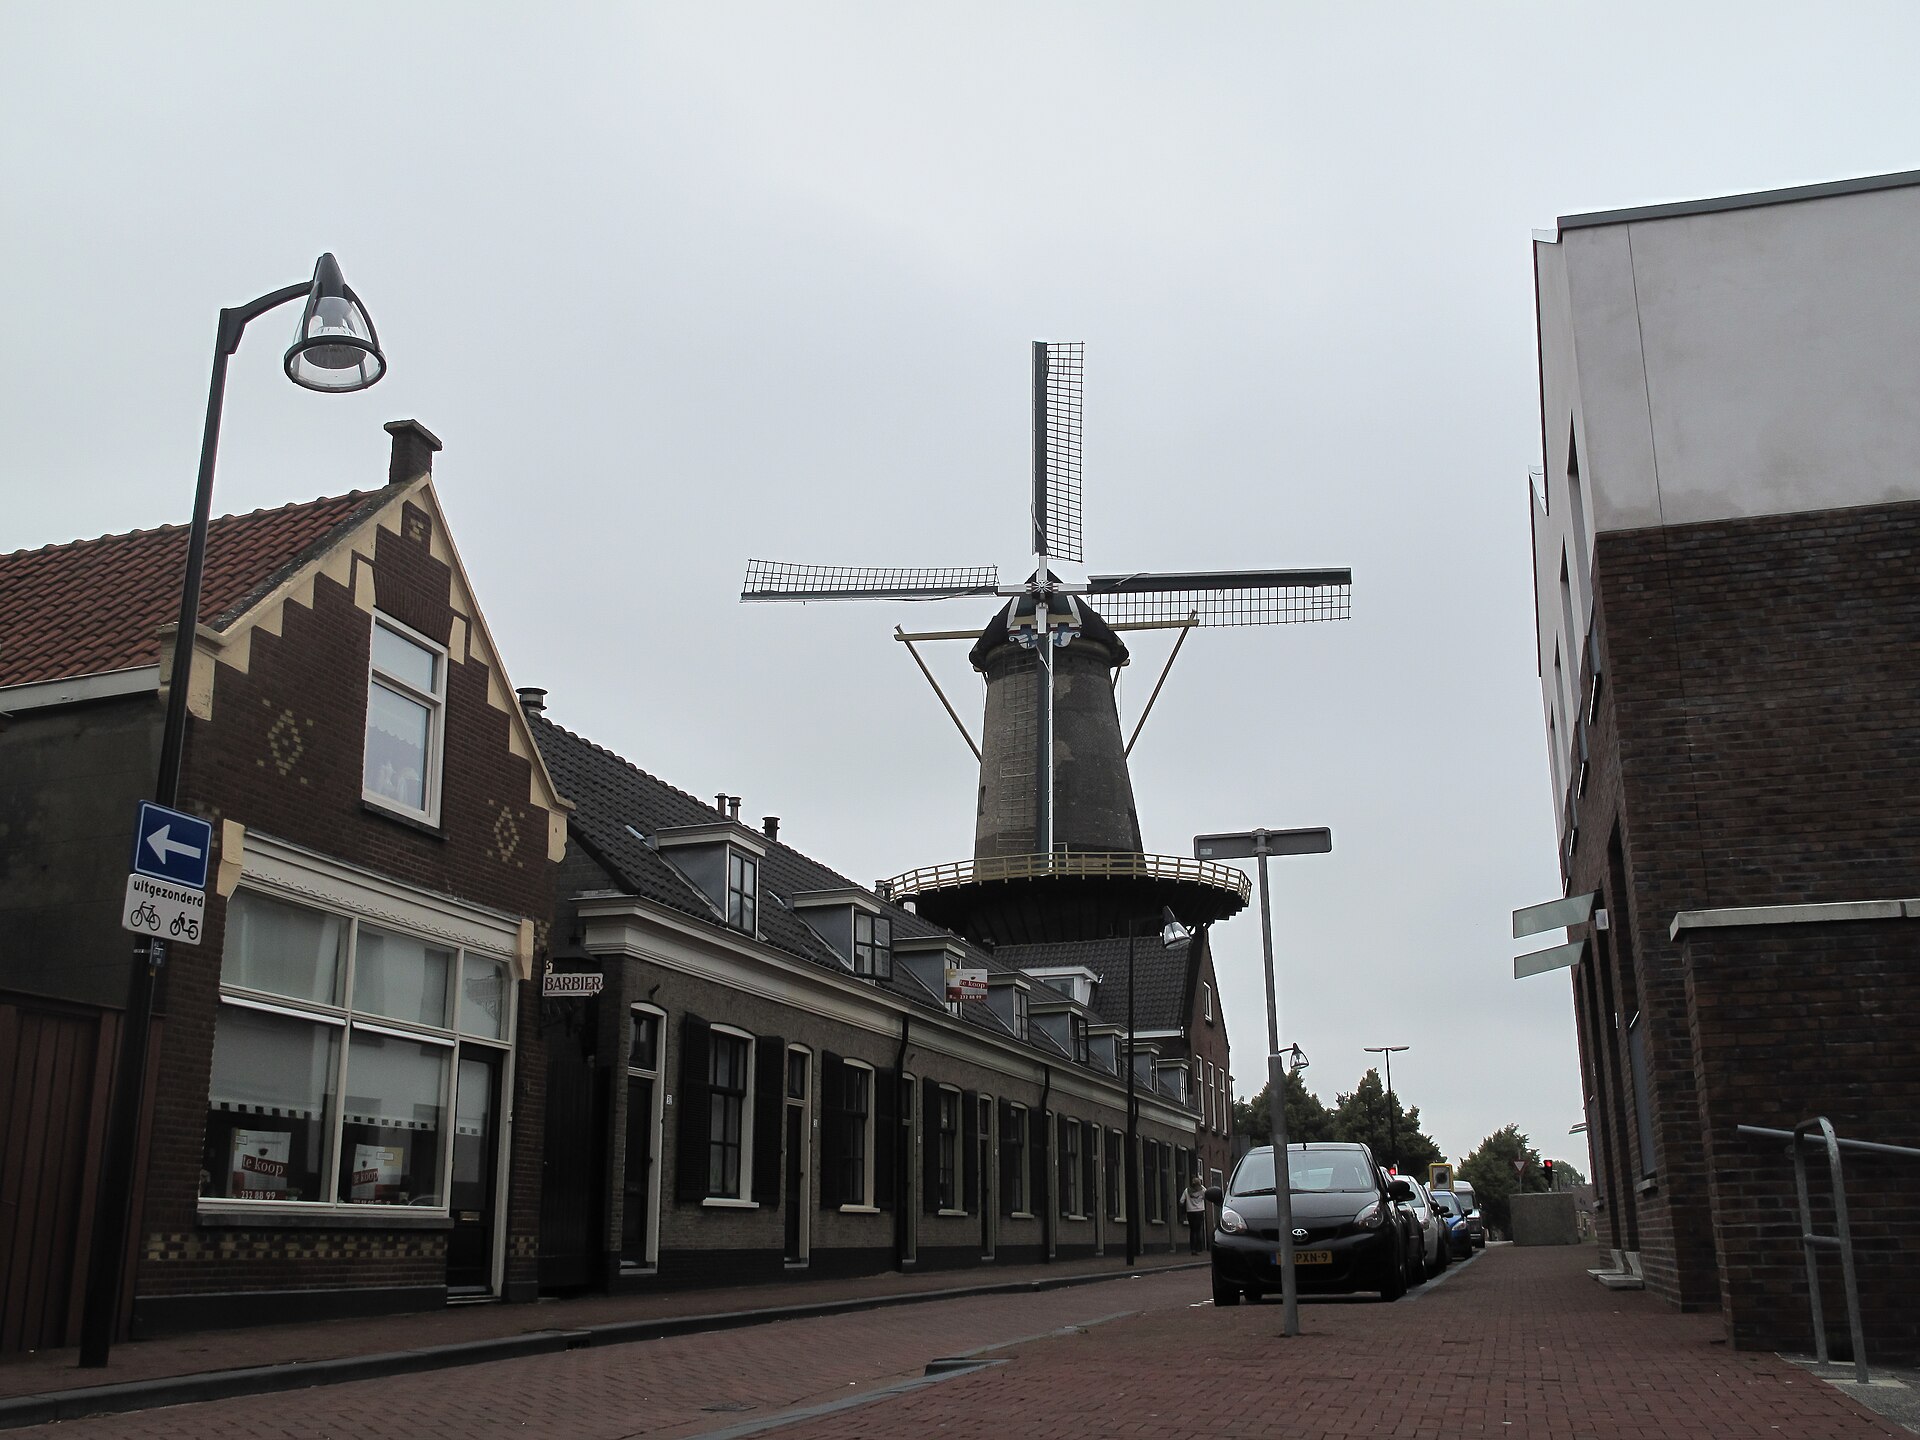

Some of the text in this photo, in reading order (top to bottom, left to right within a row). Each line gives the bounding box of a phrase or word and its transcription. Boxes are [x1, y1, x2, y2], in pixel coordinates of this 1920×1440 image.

[134, 880, 203, 907] uitgezonderd
[544, 976, 600, 991] BARBIER
[968, 979, 985, 988] koop
[254, 1157, 284, 1177] koop
[241, 1190, 276, 1200] 232 88 99
